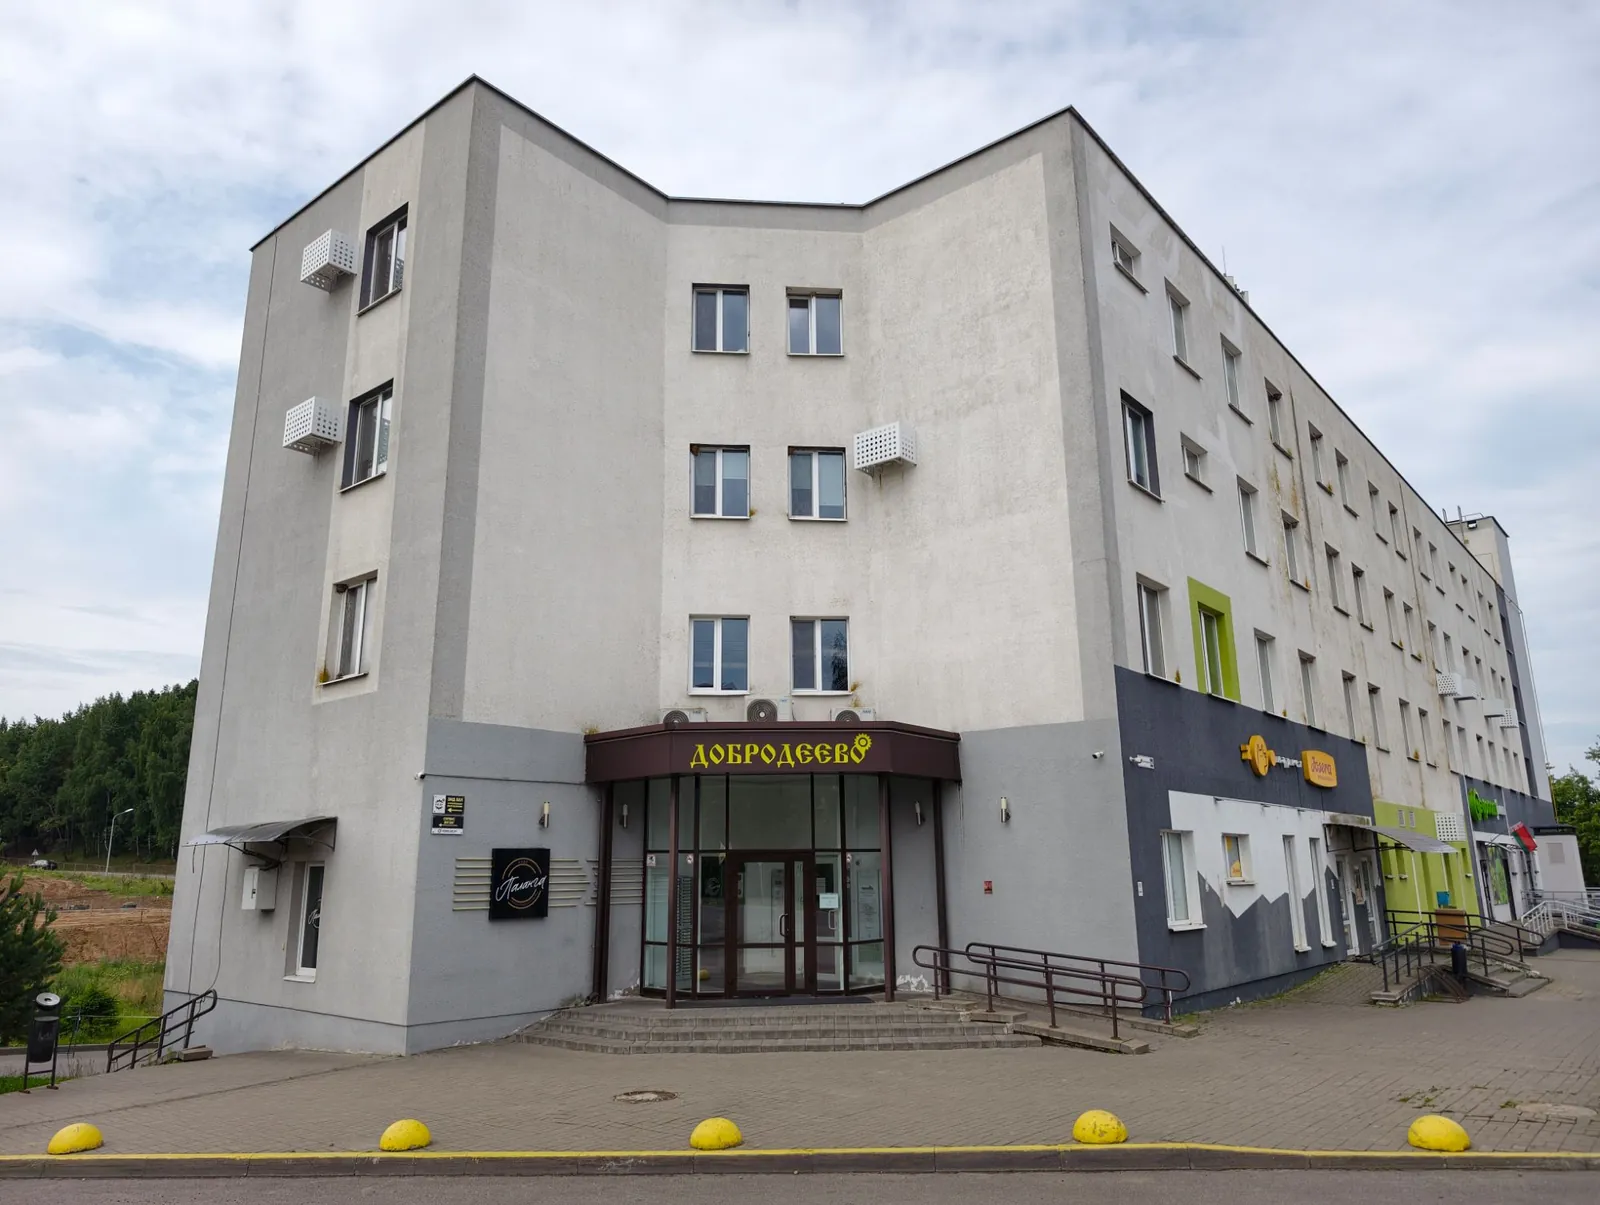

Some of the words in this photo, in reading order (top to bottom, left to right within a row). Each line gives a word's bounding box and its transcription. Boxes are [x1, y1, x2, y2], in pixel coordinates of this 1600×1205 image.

[690, 739, 867, 768] ДОБРОДЕЕВО
[1311, 757, 1332, 775] Josera
[495, 876, 547, 901] Паланга
